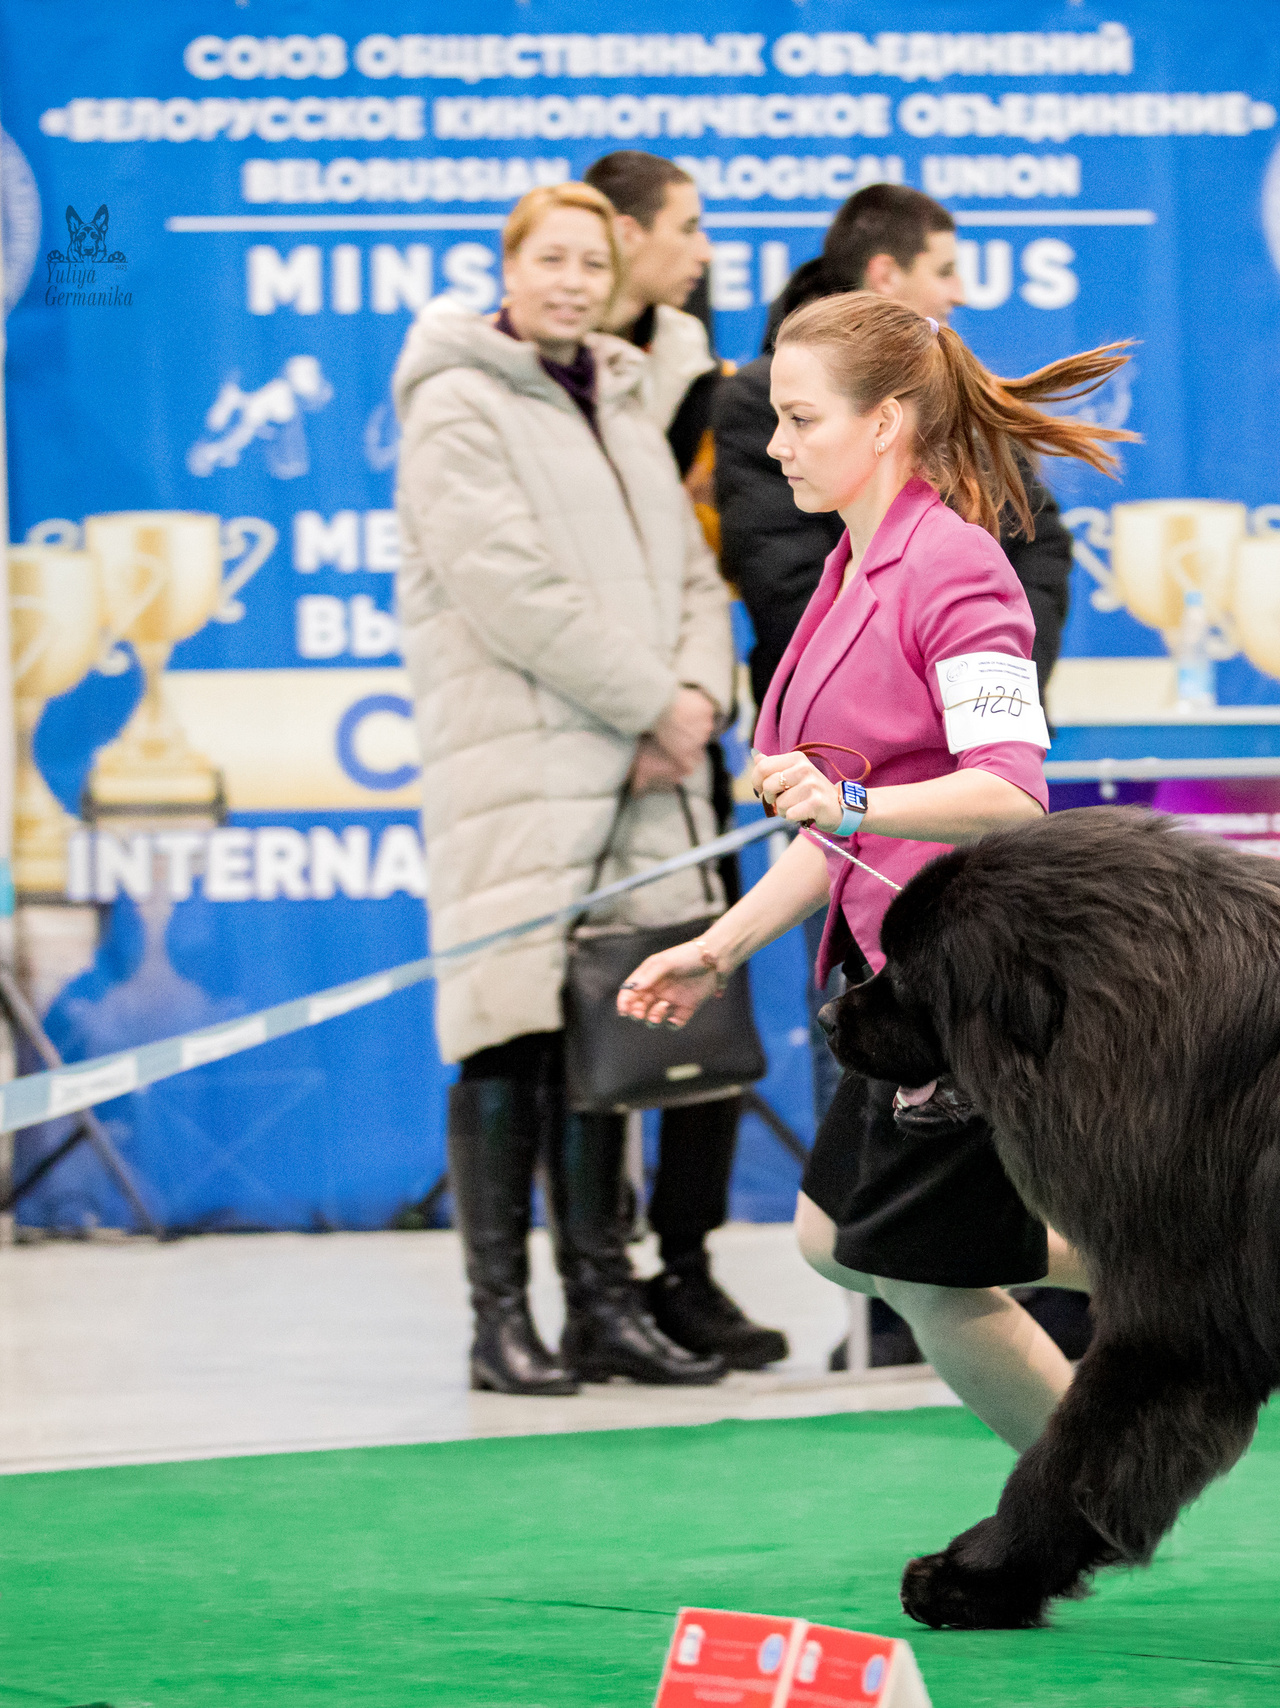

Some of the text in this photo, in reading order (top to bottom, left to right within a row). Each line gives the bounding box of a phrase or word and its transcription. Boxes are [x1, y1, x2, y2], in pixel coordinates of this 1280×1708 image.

[184, 21, 1133, 83] СОЮЗ ОБЩЕСТВЕННЫХ ОБЪЕДИНЕНИЙ
[432, 93, 891, 140] КИНОЛОГИЧЕСКОЕ
[241, 157, 571, 204] BELORUSSIAN
[921, 153, 1082, 200] UNION
[247, 242, 500, 316] MINS
[972, 685, 1023, 718] 420
[67, 826, 431, 900] INTERNA
